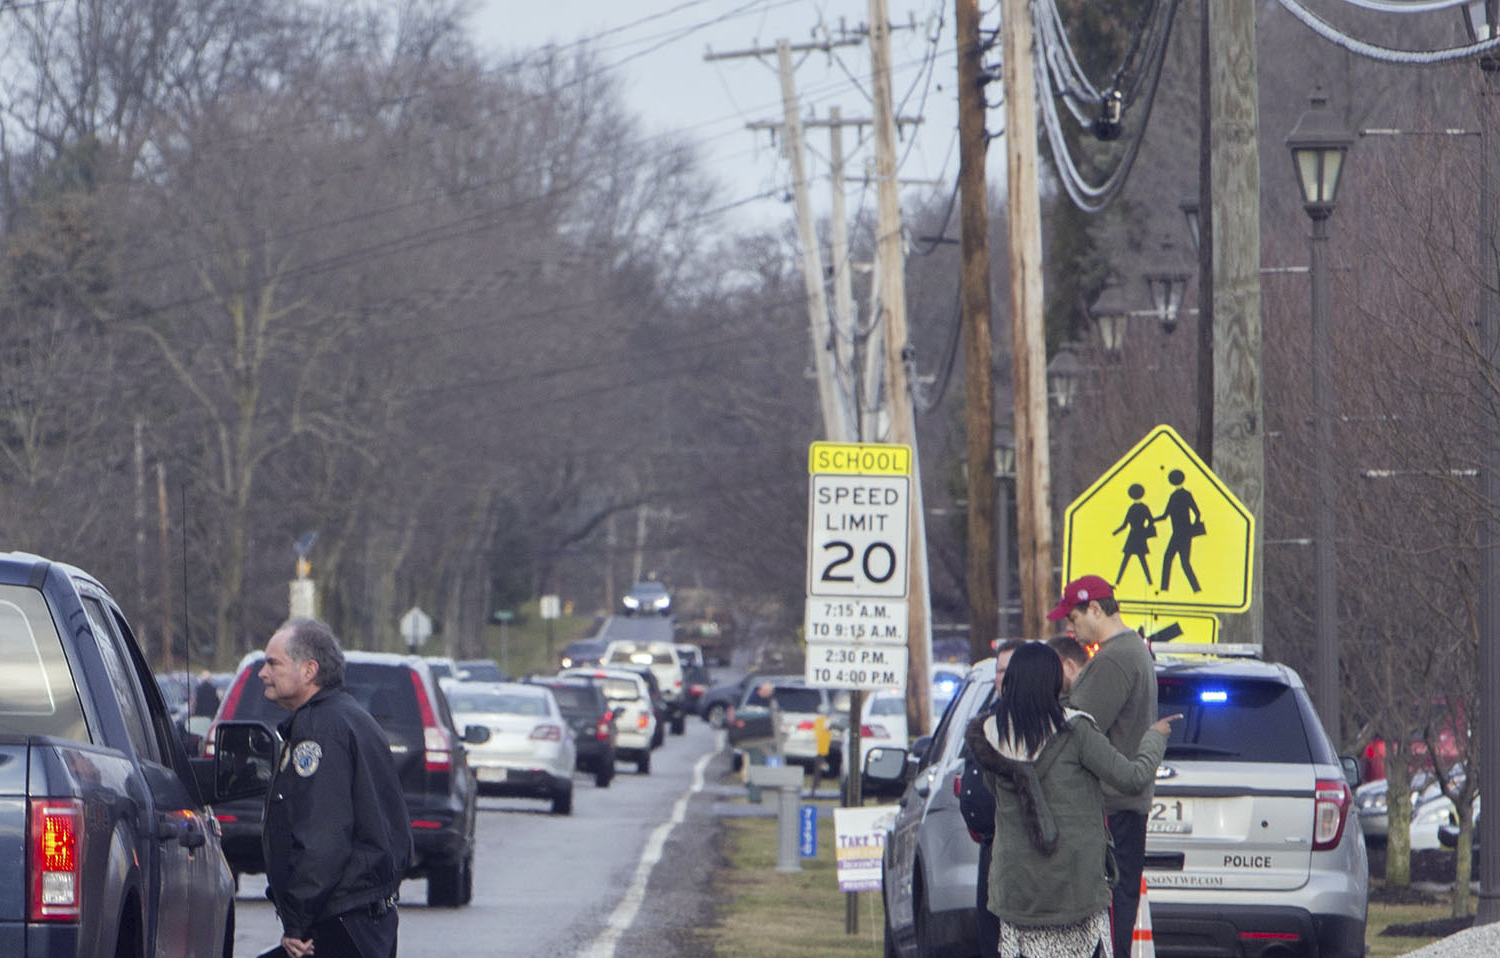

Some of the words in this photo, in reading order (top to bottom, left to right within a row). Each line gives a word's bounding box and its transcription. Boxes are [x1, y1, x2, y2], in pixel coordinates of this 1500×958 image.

[817, 450, 904, 471] SCHOOL
[818, 486, 899, 506] SPEED
[826, 513, 889, 532] LIMIT
[821, 541, 896, 583] 20
[824, 603, 853, 617] 7:15
[860, 605, 891, 618] A.M.
[813, 623, 829, 636] TO
[835, 624, 866, 638] 9:15
[871, 625, 902, 639] A.M.
[825, 649, 856, 664] 2:30
[861, 651, 889, 665] P.M.
[815, 668, 831, 681] TO
[836, 669, 867, 683] 4:00
[872, 670, 899, 685] P.M.
[1151, 801, 1183, 821] 21
[840, 835, 869, 848] TAKE
[873, 833, 887, 847] T
[1224, 855, 1272, 868] POLICE
